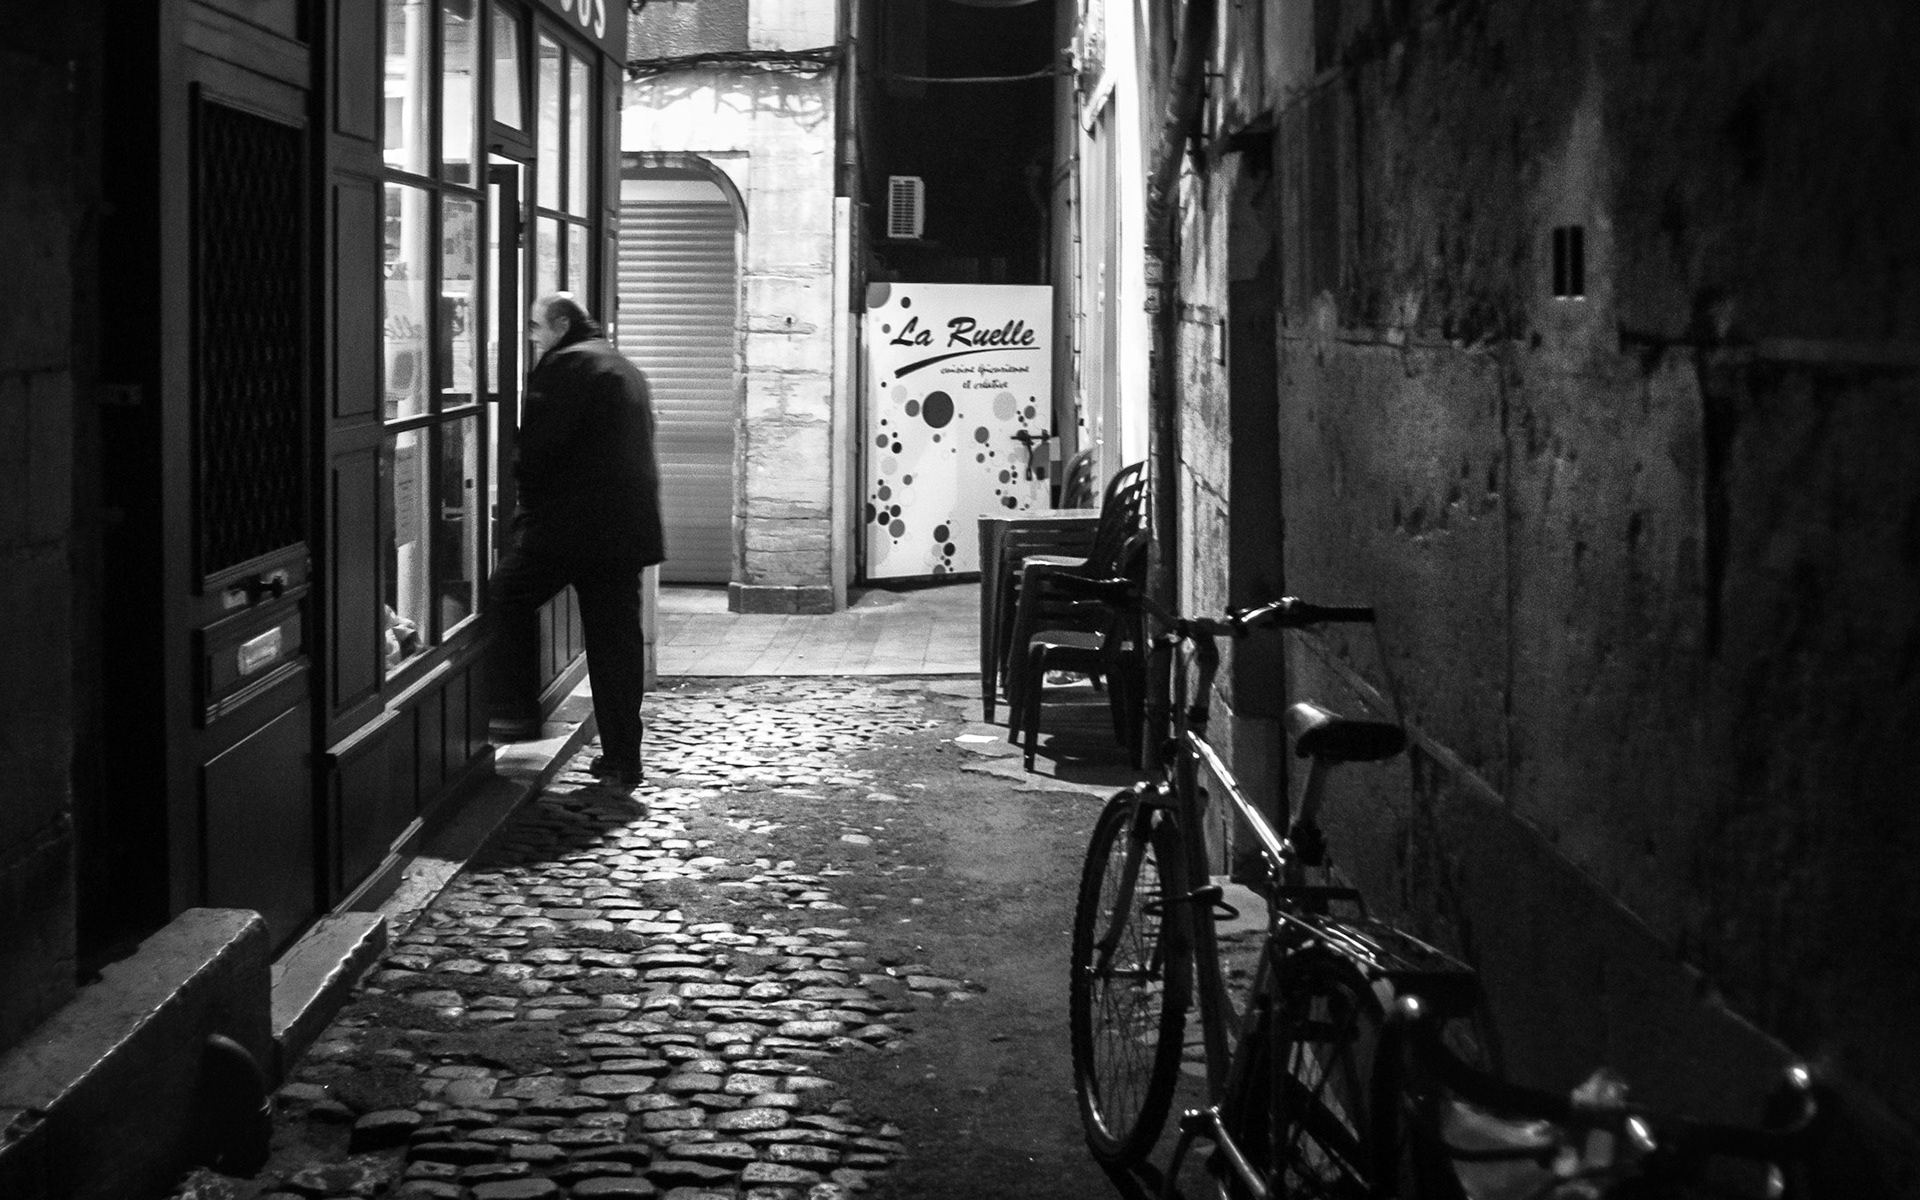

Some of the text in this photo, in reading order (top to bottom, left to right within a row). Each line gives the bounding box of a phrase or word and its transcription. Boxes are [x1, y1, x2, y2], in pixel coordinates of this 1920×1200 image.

[890, 316, 1035, 347] La Ruelle
[940, 364, 975, 374] cuisine
[962, 380, 971, 389] et
